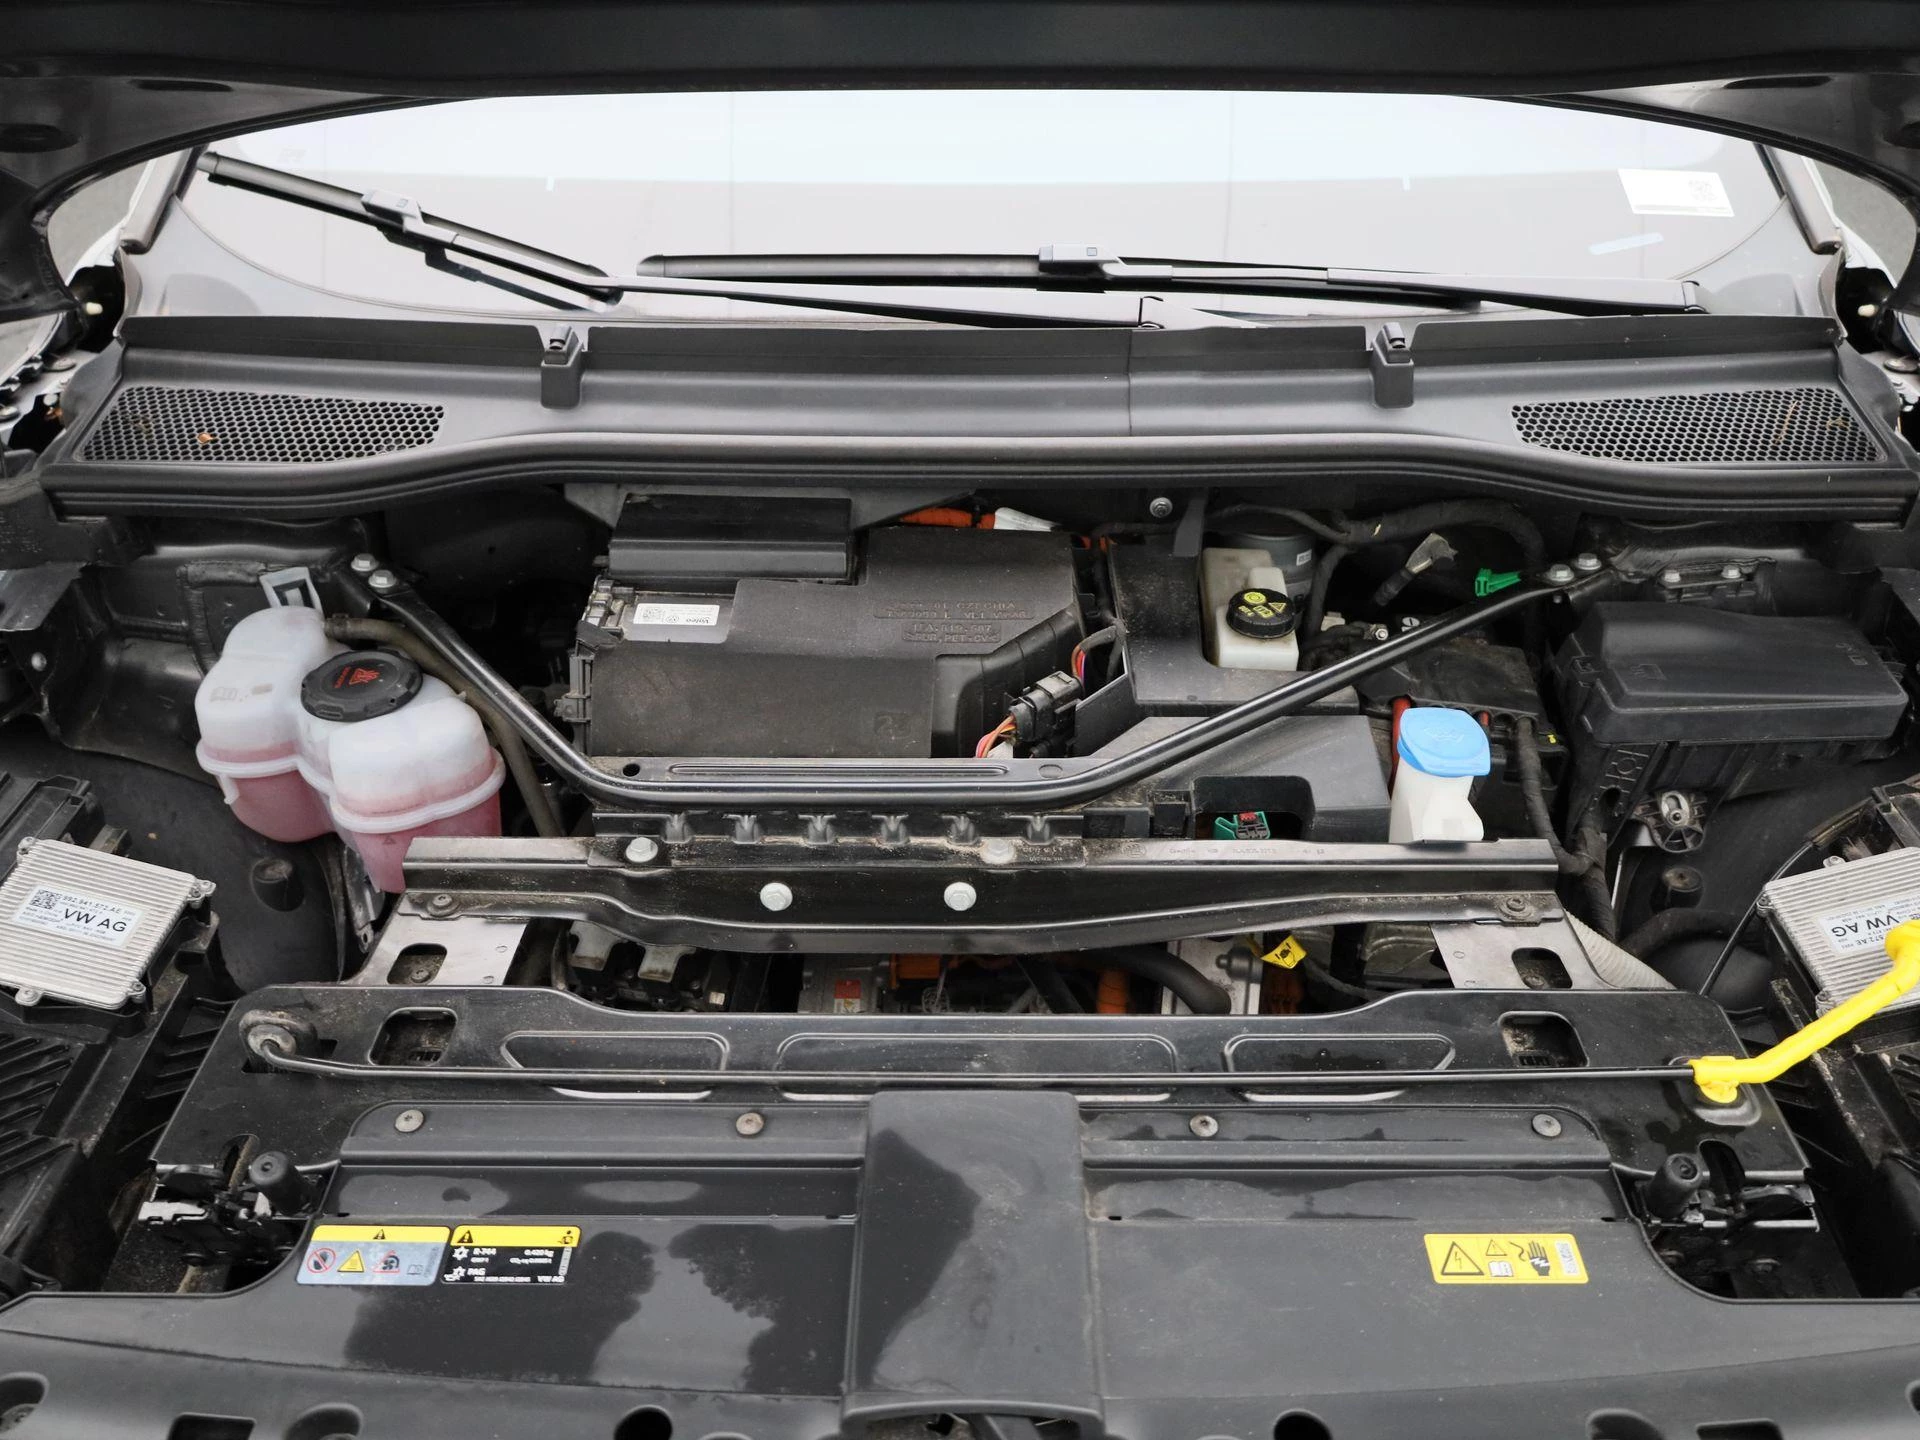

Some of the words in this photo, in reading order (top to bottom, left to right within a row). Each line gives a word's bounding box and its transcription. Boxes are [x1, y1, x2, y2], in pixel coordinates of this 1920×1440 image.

[64, 908, 96, 924] VW
[97, 918, 127, 932] AG
[1866, 914, 1900, 930] VW
[1831, 922, 1858, 937] AG
